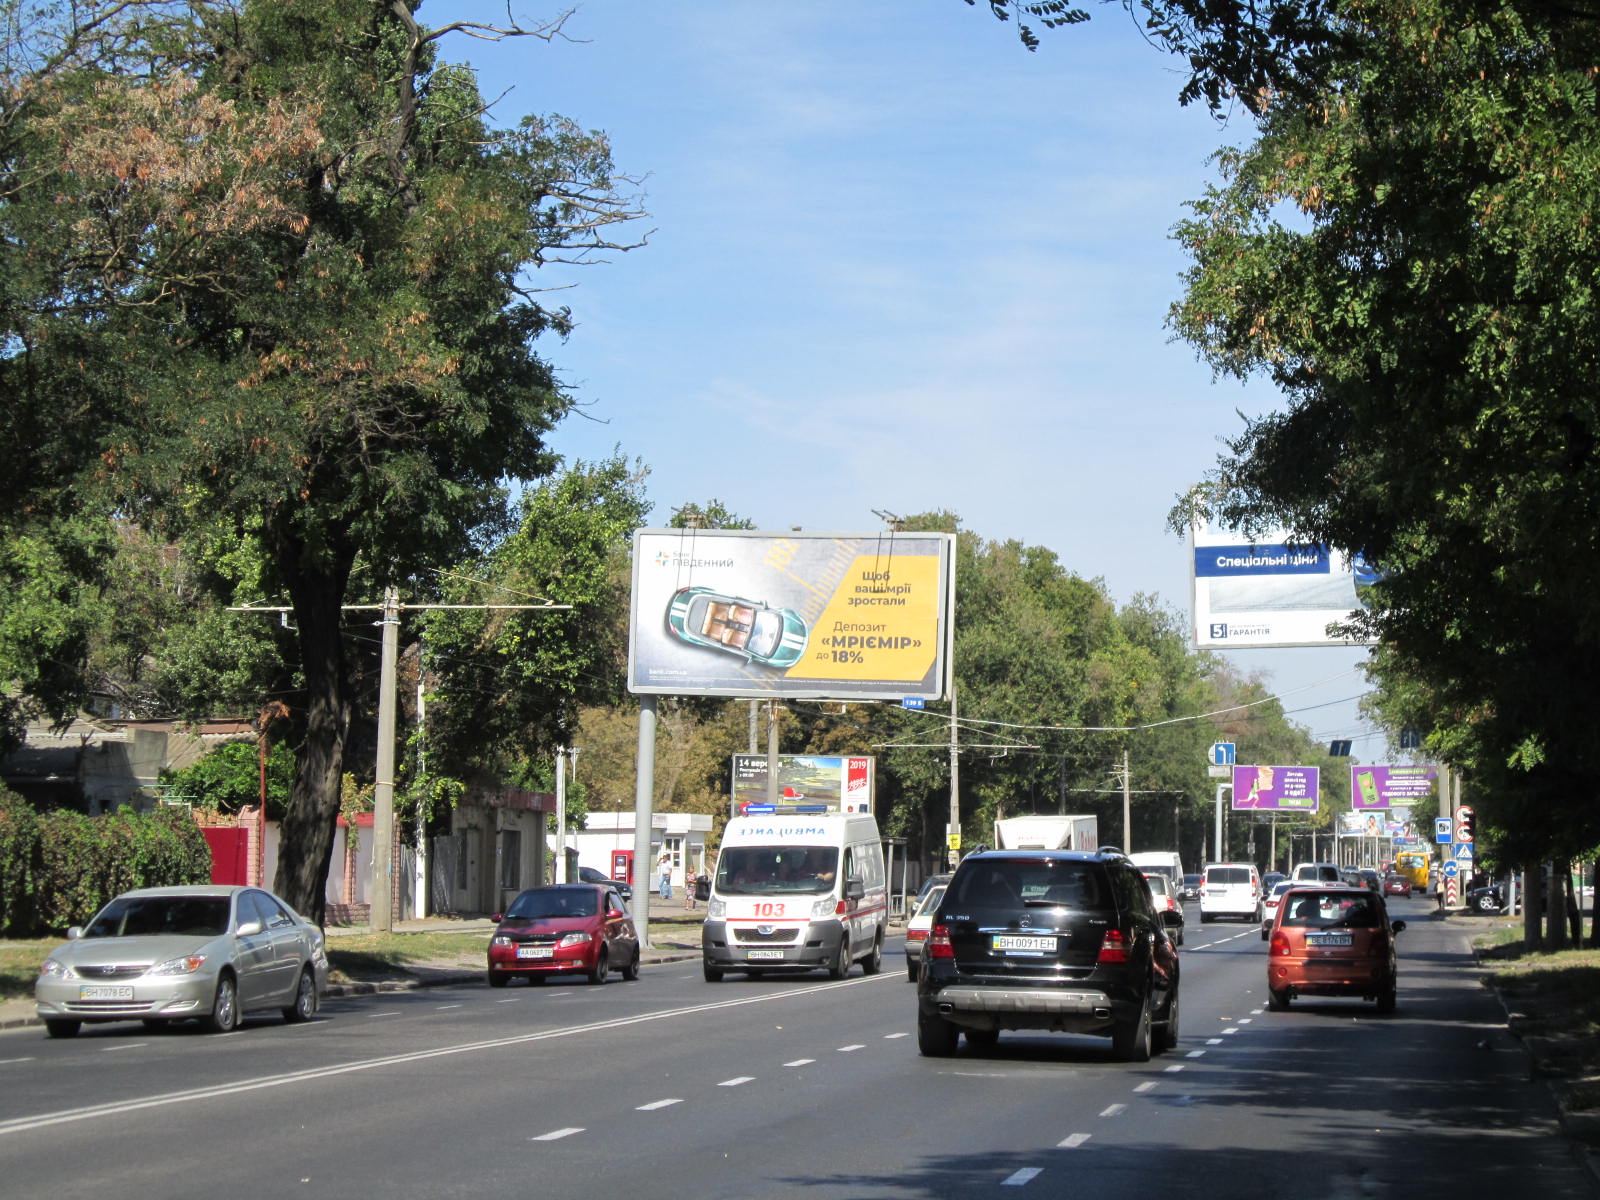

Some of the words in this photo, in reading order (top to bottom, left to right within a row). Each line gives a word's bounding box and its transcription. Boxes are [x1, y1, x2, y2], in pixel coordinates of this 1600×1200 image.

[673, 558, 734, 568] ПІВДЕННИЙ
[1217, 554, 1287, 567] Спеціальні
[1290, 553, 1318, 565] ціни
[863, 571, 890, 581] Щоб
[855, 583, 883, 593] ваші
[886, 584, 911, 595] мрії
[848, 597, 905, 607] зростали
[833, 621, 886, 632] Депозит
[1230, 628, 1270, 636] ГАРАНТІЯ
[822, 635, 921, 649] «МРІЄМІР»
[816, 652, 829, 660] до
[832, 650, 864, 663] 18%
[739, 759, 749, 767] 14
[850, 760, 866, 769] 2019
[752, 903, 785, 917] 103
[1016, 938, 1038, 948] 0091
